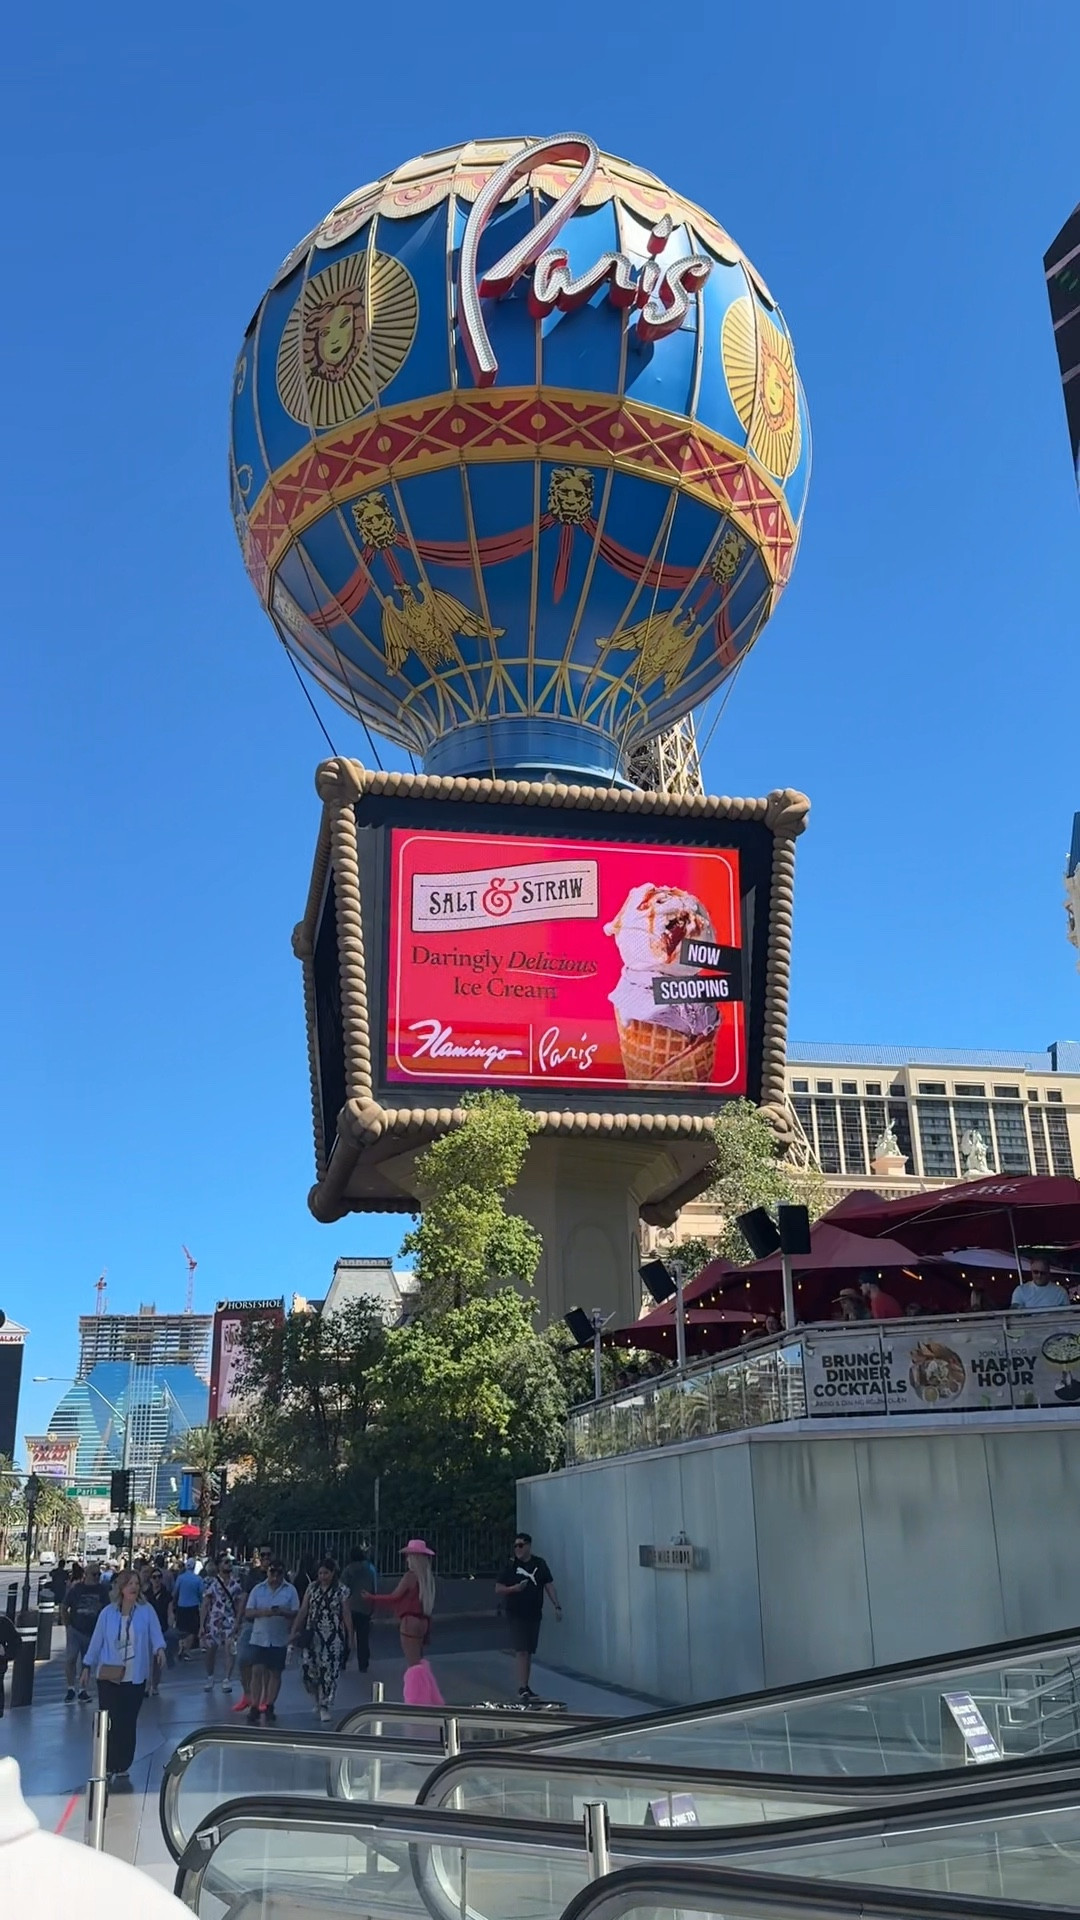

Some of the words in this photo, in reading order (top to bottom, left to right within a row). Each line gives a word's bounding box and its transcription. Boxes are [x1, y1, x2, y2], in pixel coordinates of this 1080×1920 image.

[458, 131, 714, 388] Paris
[429, 889, 478, 915] SALT
[482, 877, 520, 917] &
[521, 877, 584, 904] STRAW
[411, 946, 504, 972] Daringly
[508, 951, 598, 975] Delicious
[687, 943, 721, 967] NOW
[454, 976, 482, 997] Ice
[487, 980, 560, 1001] Cream
[660, 979, 730, 1001] SCOOPING
[408, 1019, 523, 1069] Flamingo
[538, 1026, 599, 1072] Paris
[228, 1300, 282, 1310] HORSESHOE
[821, 1351, 893, 1369] BRUNCH
[971, 1355, 1037, 1373] HAPPY
[826, 1366, 891, 1383] DINNER
[977, 1371, 1034, 1388] HOUR
[813, 1380, 908, 1398] COCKTAILS
[76, 1488, 98, 1496] Paris
